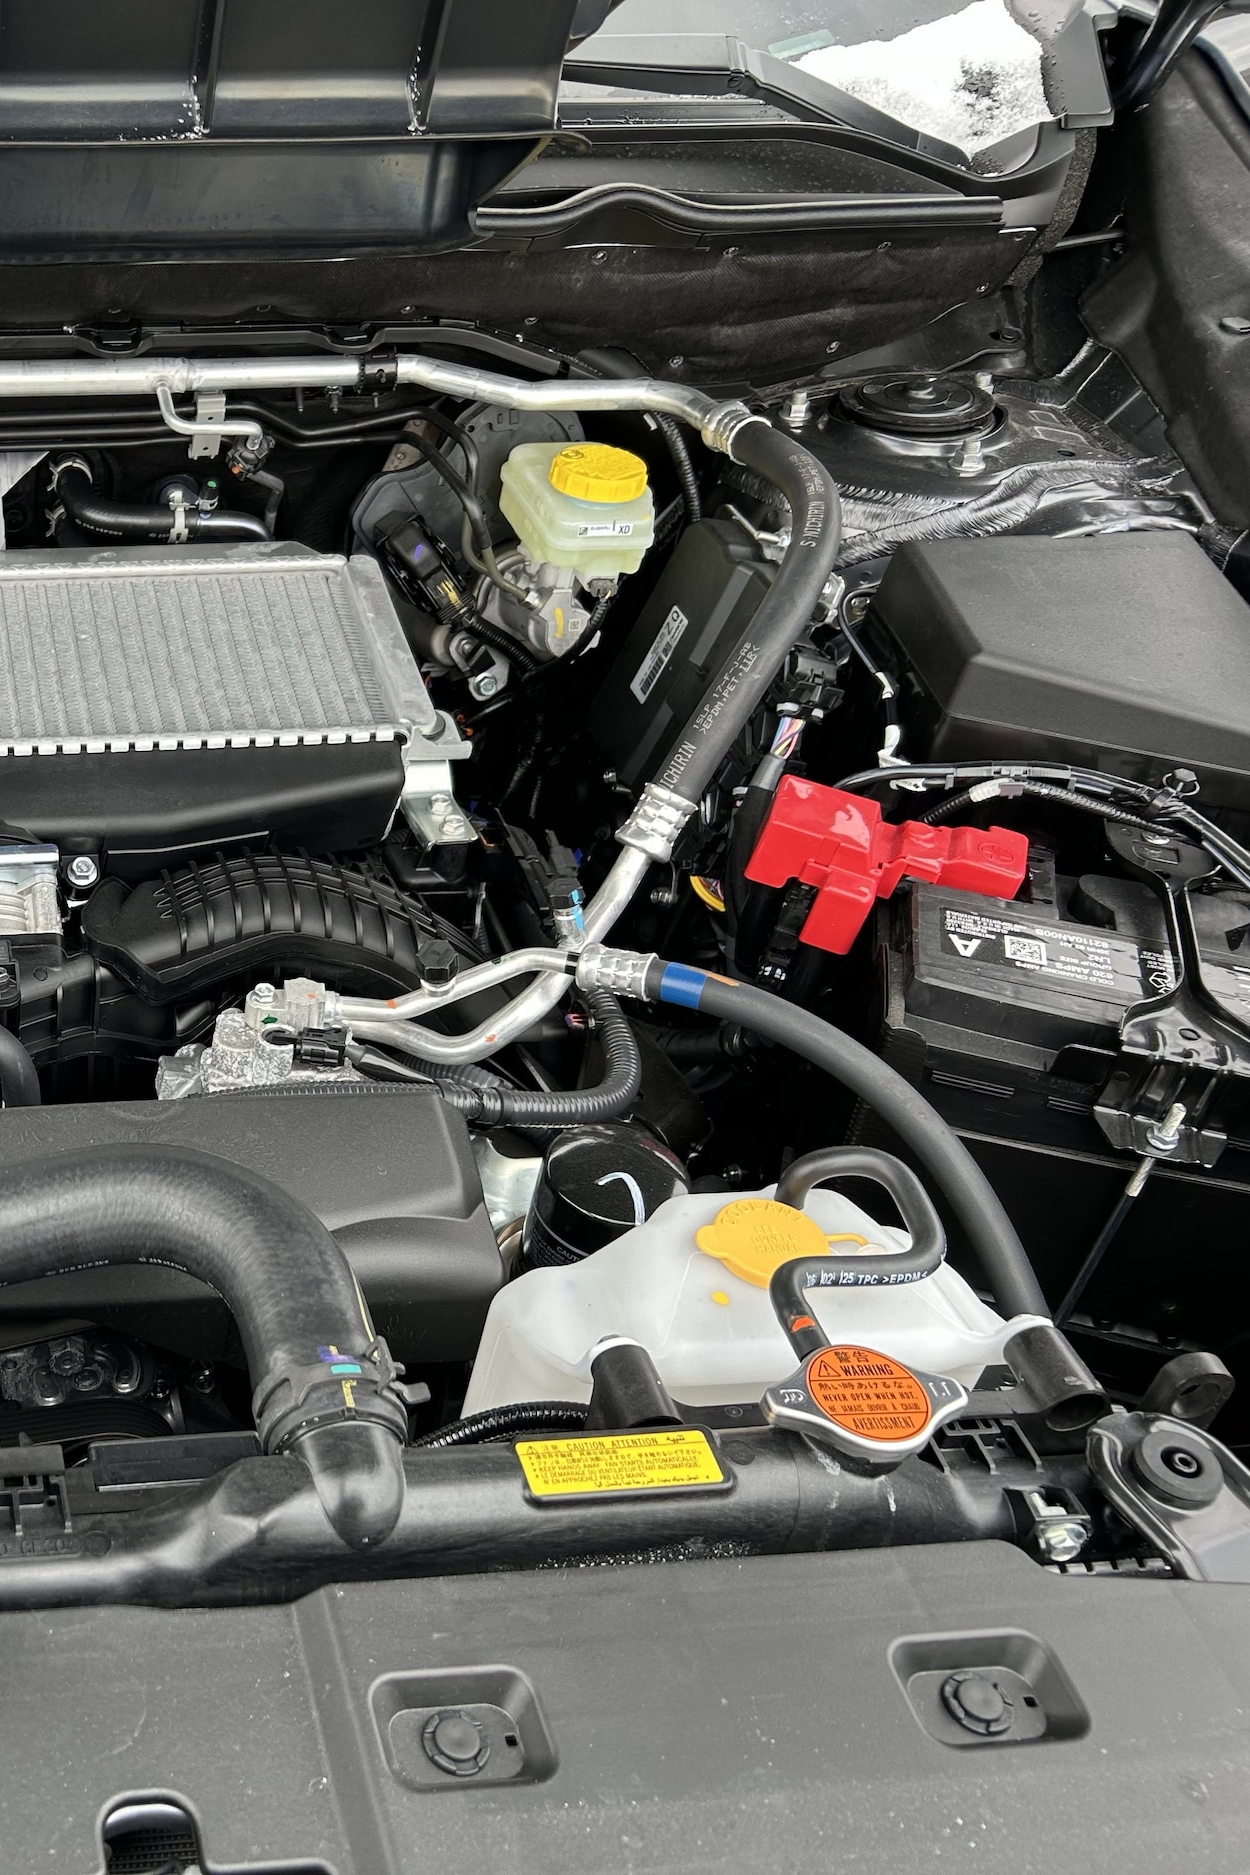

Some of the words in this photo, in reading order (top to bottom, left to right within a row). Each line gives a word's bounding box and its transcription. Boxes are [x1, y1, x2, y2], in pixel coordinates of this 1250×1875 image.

[618, 525, 631, 534] XD
[692, 703, 711, 730] 15LP
[1088, 954, 1111, 965] LN2
[1015, 961, 1040, 971] AMPS
[1055, 962, 1090, 974] AMPS
[1081, 960, 1113, 971] GROUP
[1041, 967, 1088, 980] CRANKING
[1089, 976, 1115, 986] COLD
[720, 1200, 807, 1226] COOLANT
[858, 1274, 879, 1284] TPC
[834, 1350, 869, 1363] 警告
[840, 1363, 894, 1377] WARNING
[822, 1393, 848, 1402] NEVER
[850, 1392, 871, 1401] OPEN
[873, 1391, 897, 1400] WHEN
[899, 1391, 918, 1400] HOT.
[566, 1441, 606, 1451] CAUTION
[611, 1436, 659, 1448] ATTENTION
[605, 1460, 618, 1468] FAN
[619, 1458, 644, 1467] STARTS
